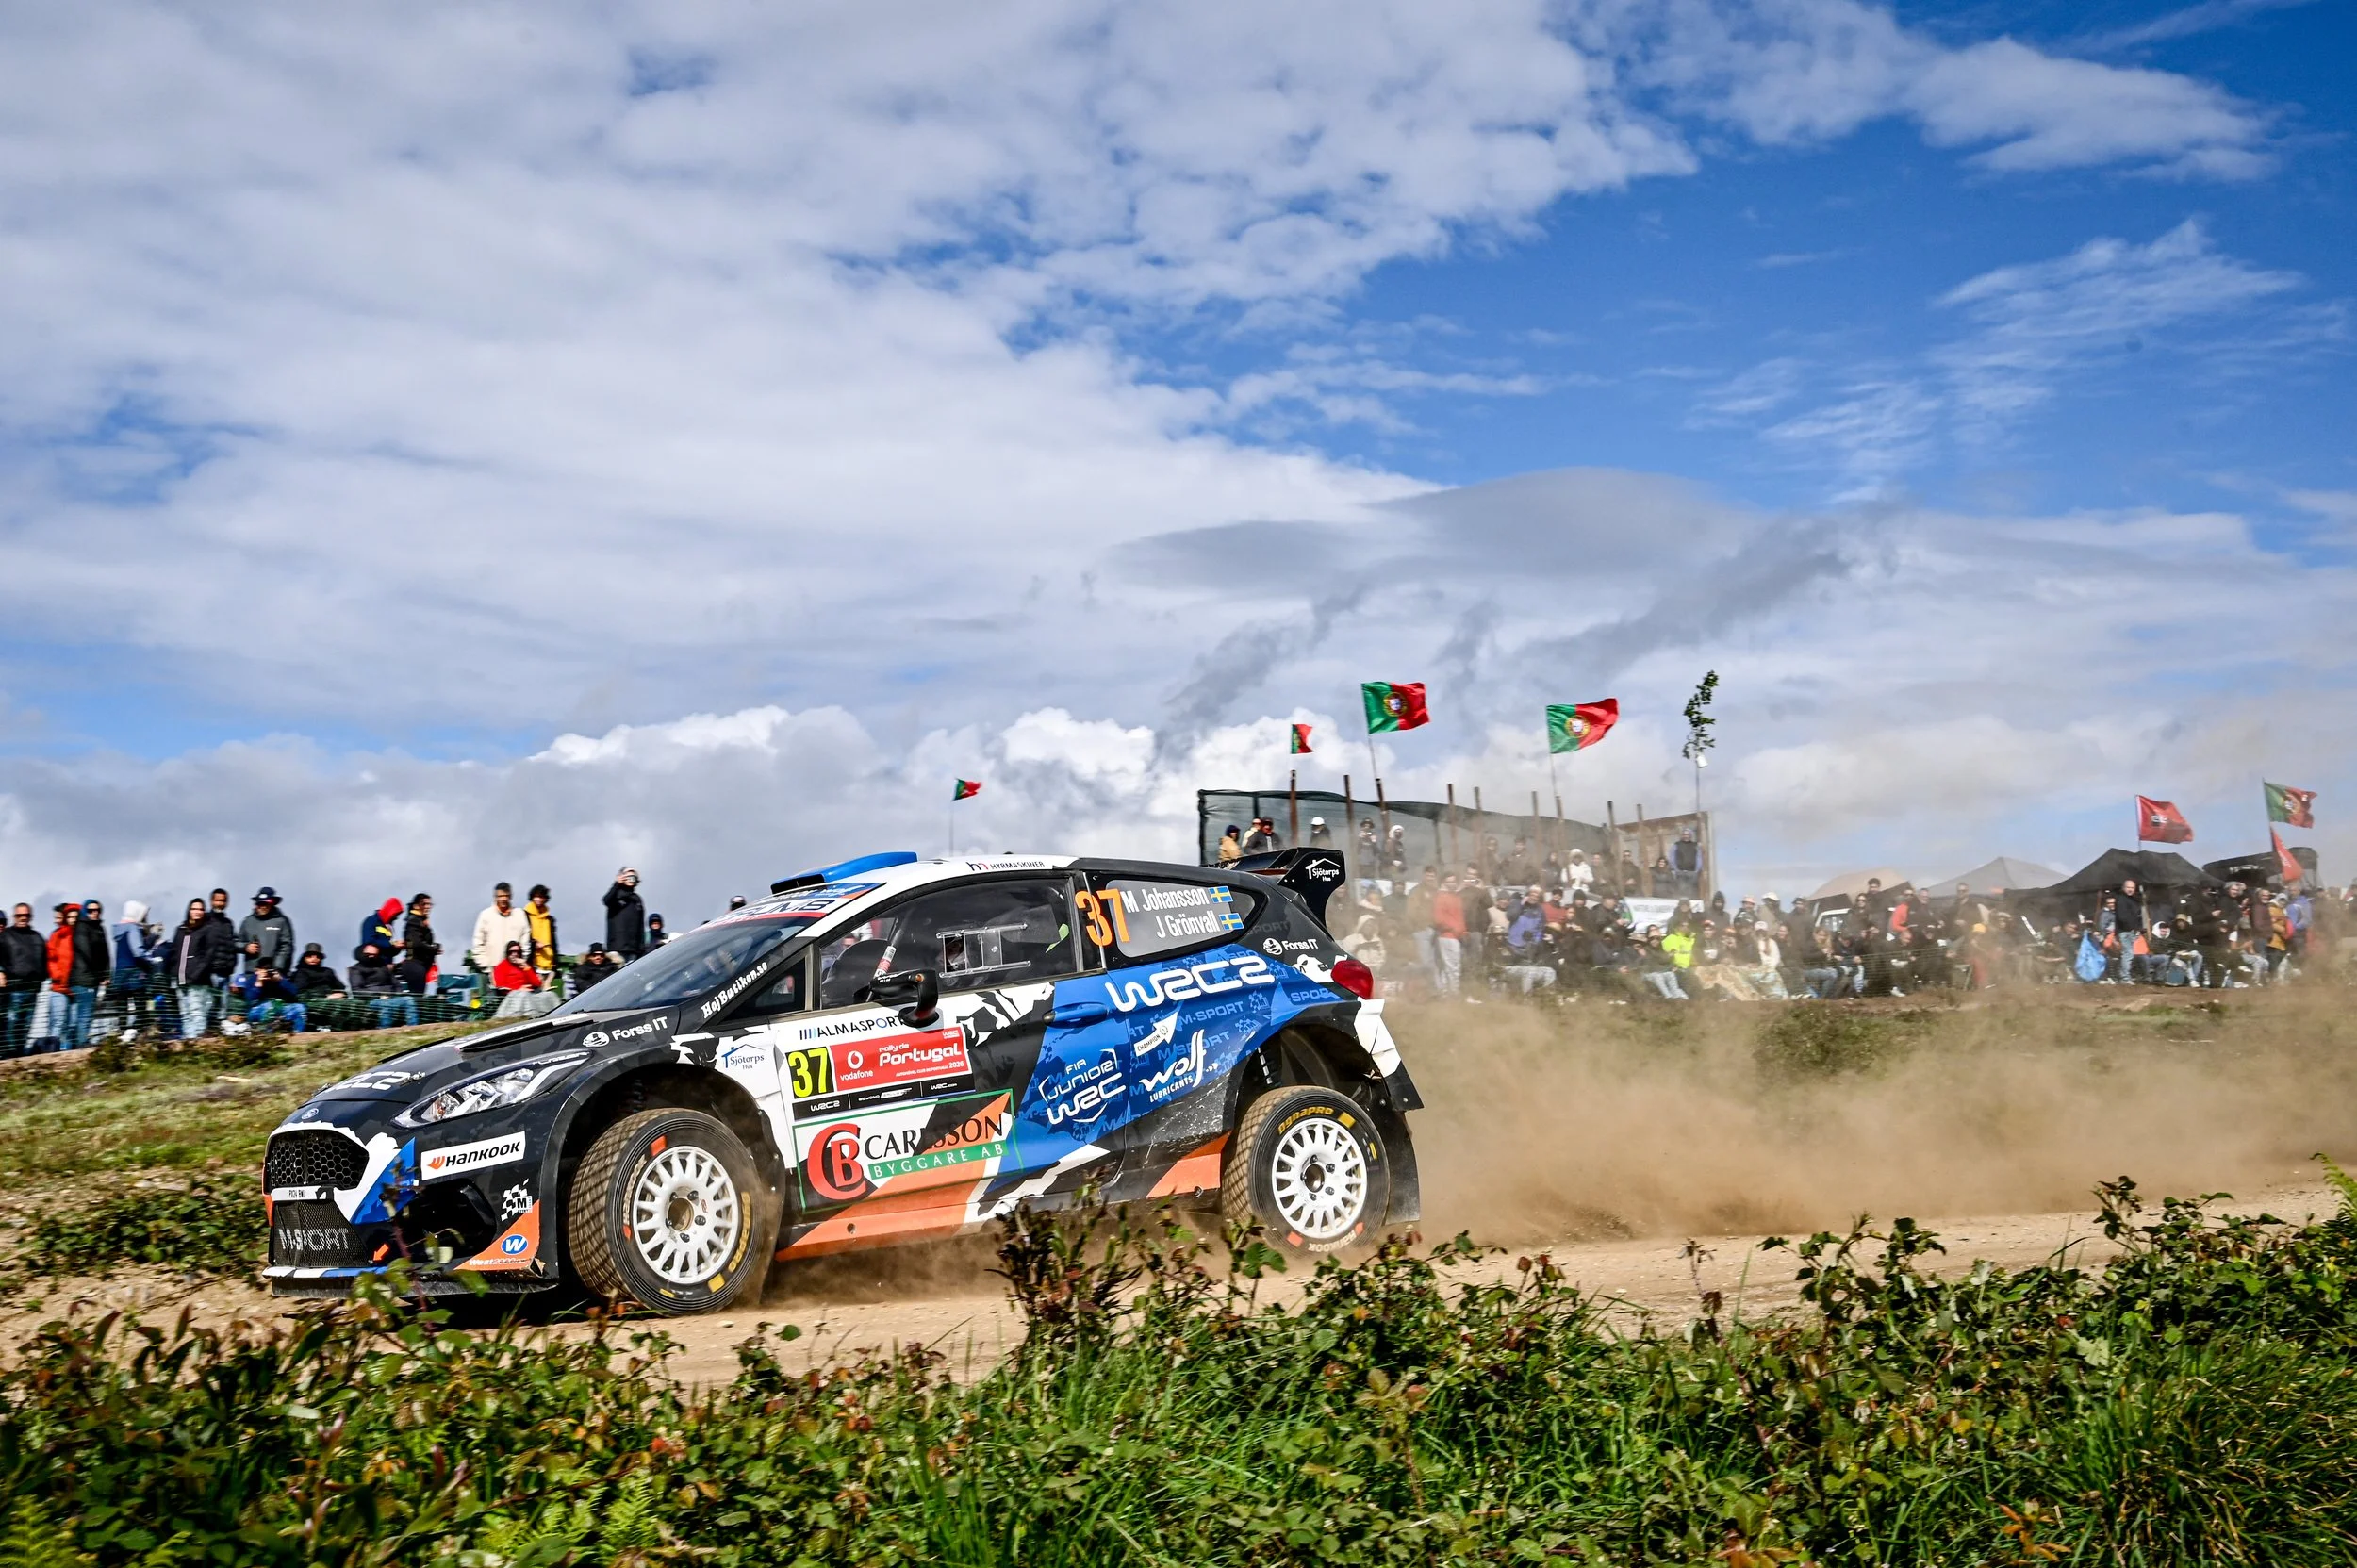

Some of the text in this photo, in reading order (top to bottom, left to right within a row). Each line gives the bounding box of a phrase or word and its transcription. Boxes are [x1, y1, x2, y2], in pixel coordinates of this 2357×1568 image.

[989, 861, 1045, 870] HYRMASKINER
[1311, 867, 1340, 880] Sjötorps
[1119, 886, 1210, 914] M Johansson
[1074, 888, 1130, 948] 37
[1156, 910, 1221, 939] J Grönvall
[1282, 938, 1319, 951] Forss IT
[701, 961, 768, 1019] HojButiken.se
[1104, 955, 1275, 1013] WRC2
[612, 1016, 668, 1041] Forss IT
[878, 1044, 898, 1053] rally
[879, 1042, 962, 1067] Portugal
[1137, 1033, 1161, 1052] CHAMPION
[730, 1054, 765, 1066] Sjötorps
[1065, 1058, 1087, 1076] FIA
[787, 1048, 828, 1098] 37
[840, 1068, 874, 1081] vodafone
[1047, 1061, 1114, 1101] JUNIOR
[1046, 1072, 1127, 1126] WRC
[1149, 1075, 1195, 1103] LUBRICANTS
[810, 1099, 840, 1113] WRC2
[981, 1143, 1004, 1157] AB
[874, 1148, 967, 1178] BYGGARE
